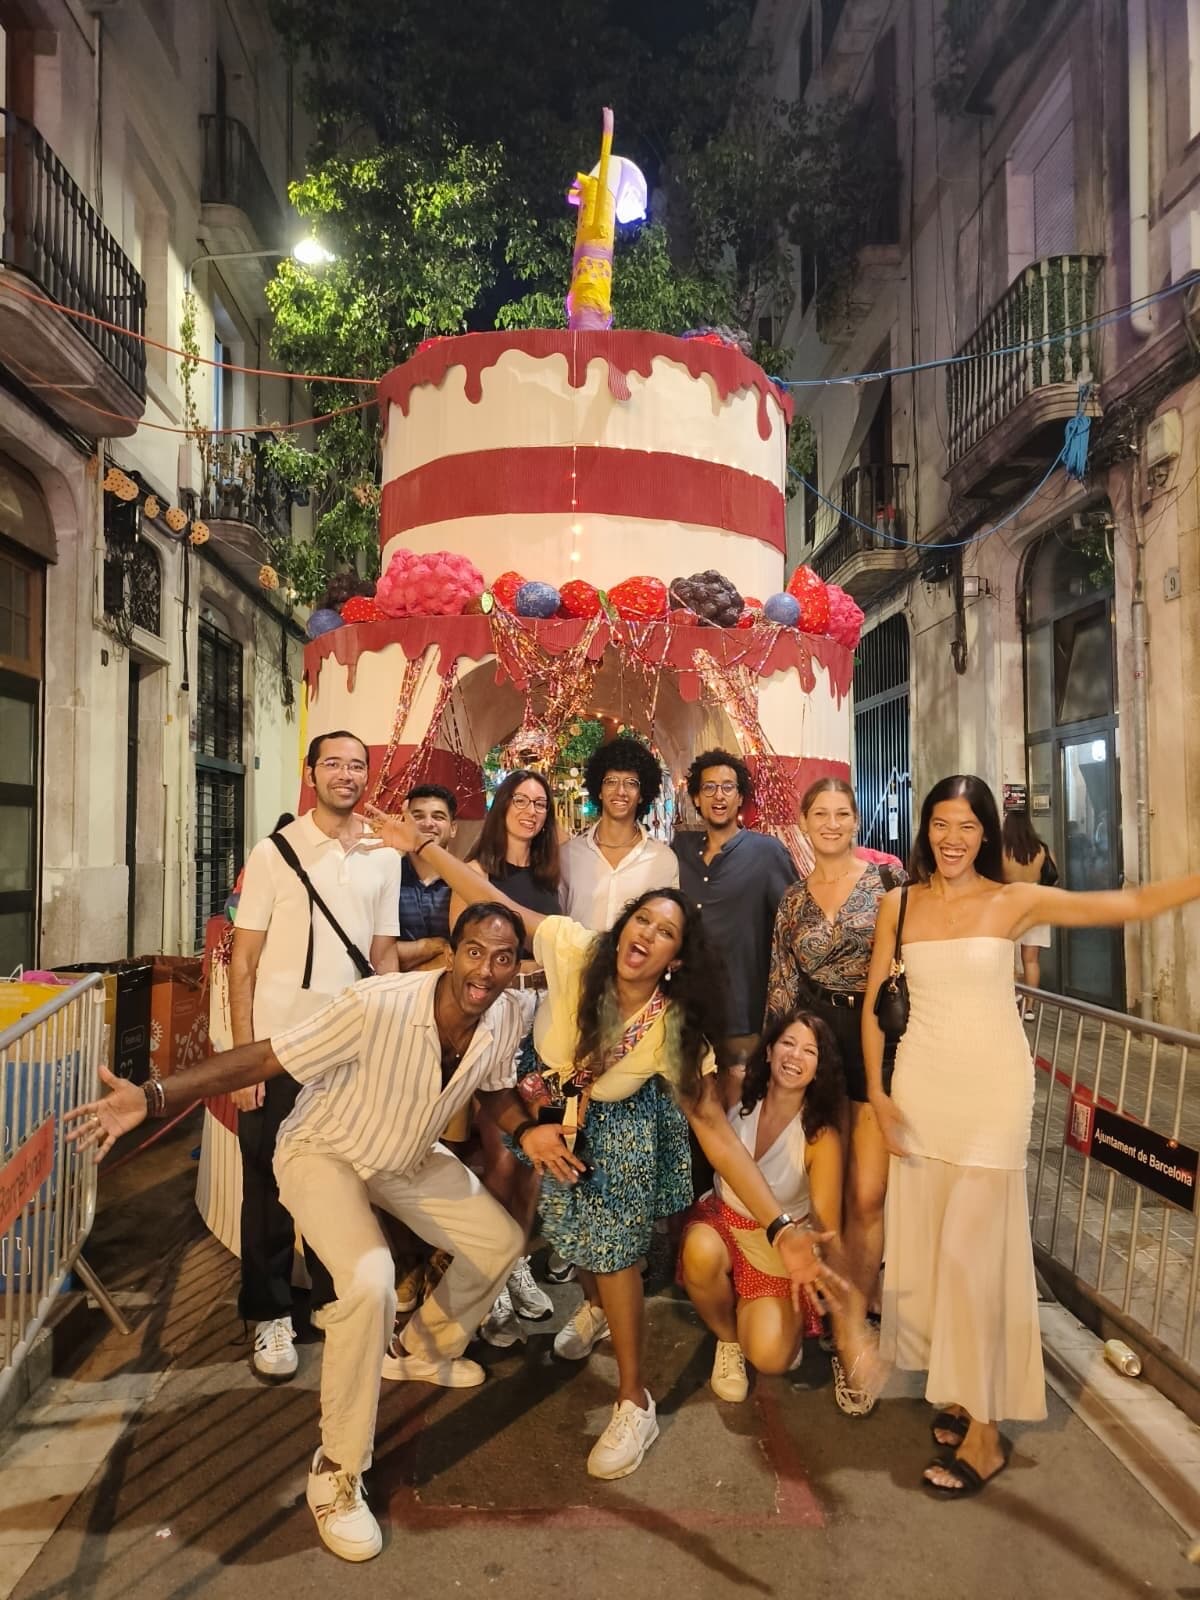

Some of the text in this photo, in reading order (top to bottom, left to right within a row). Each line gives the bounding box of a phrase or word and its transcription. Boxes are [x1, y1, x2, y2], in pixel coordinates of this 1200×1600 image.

[1170, 576, 1176, 592] 9
[1094, 1127, 1193, 1187] Ajuntament de Barcelona
